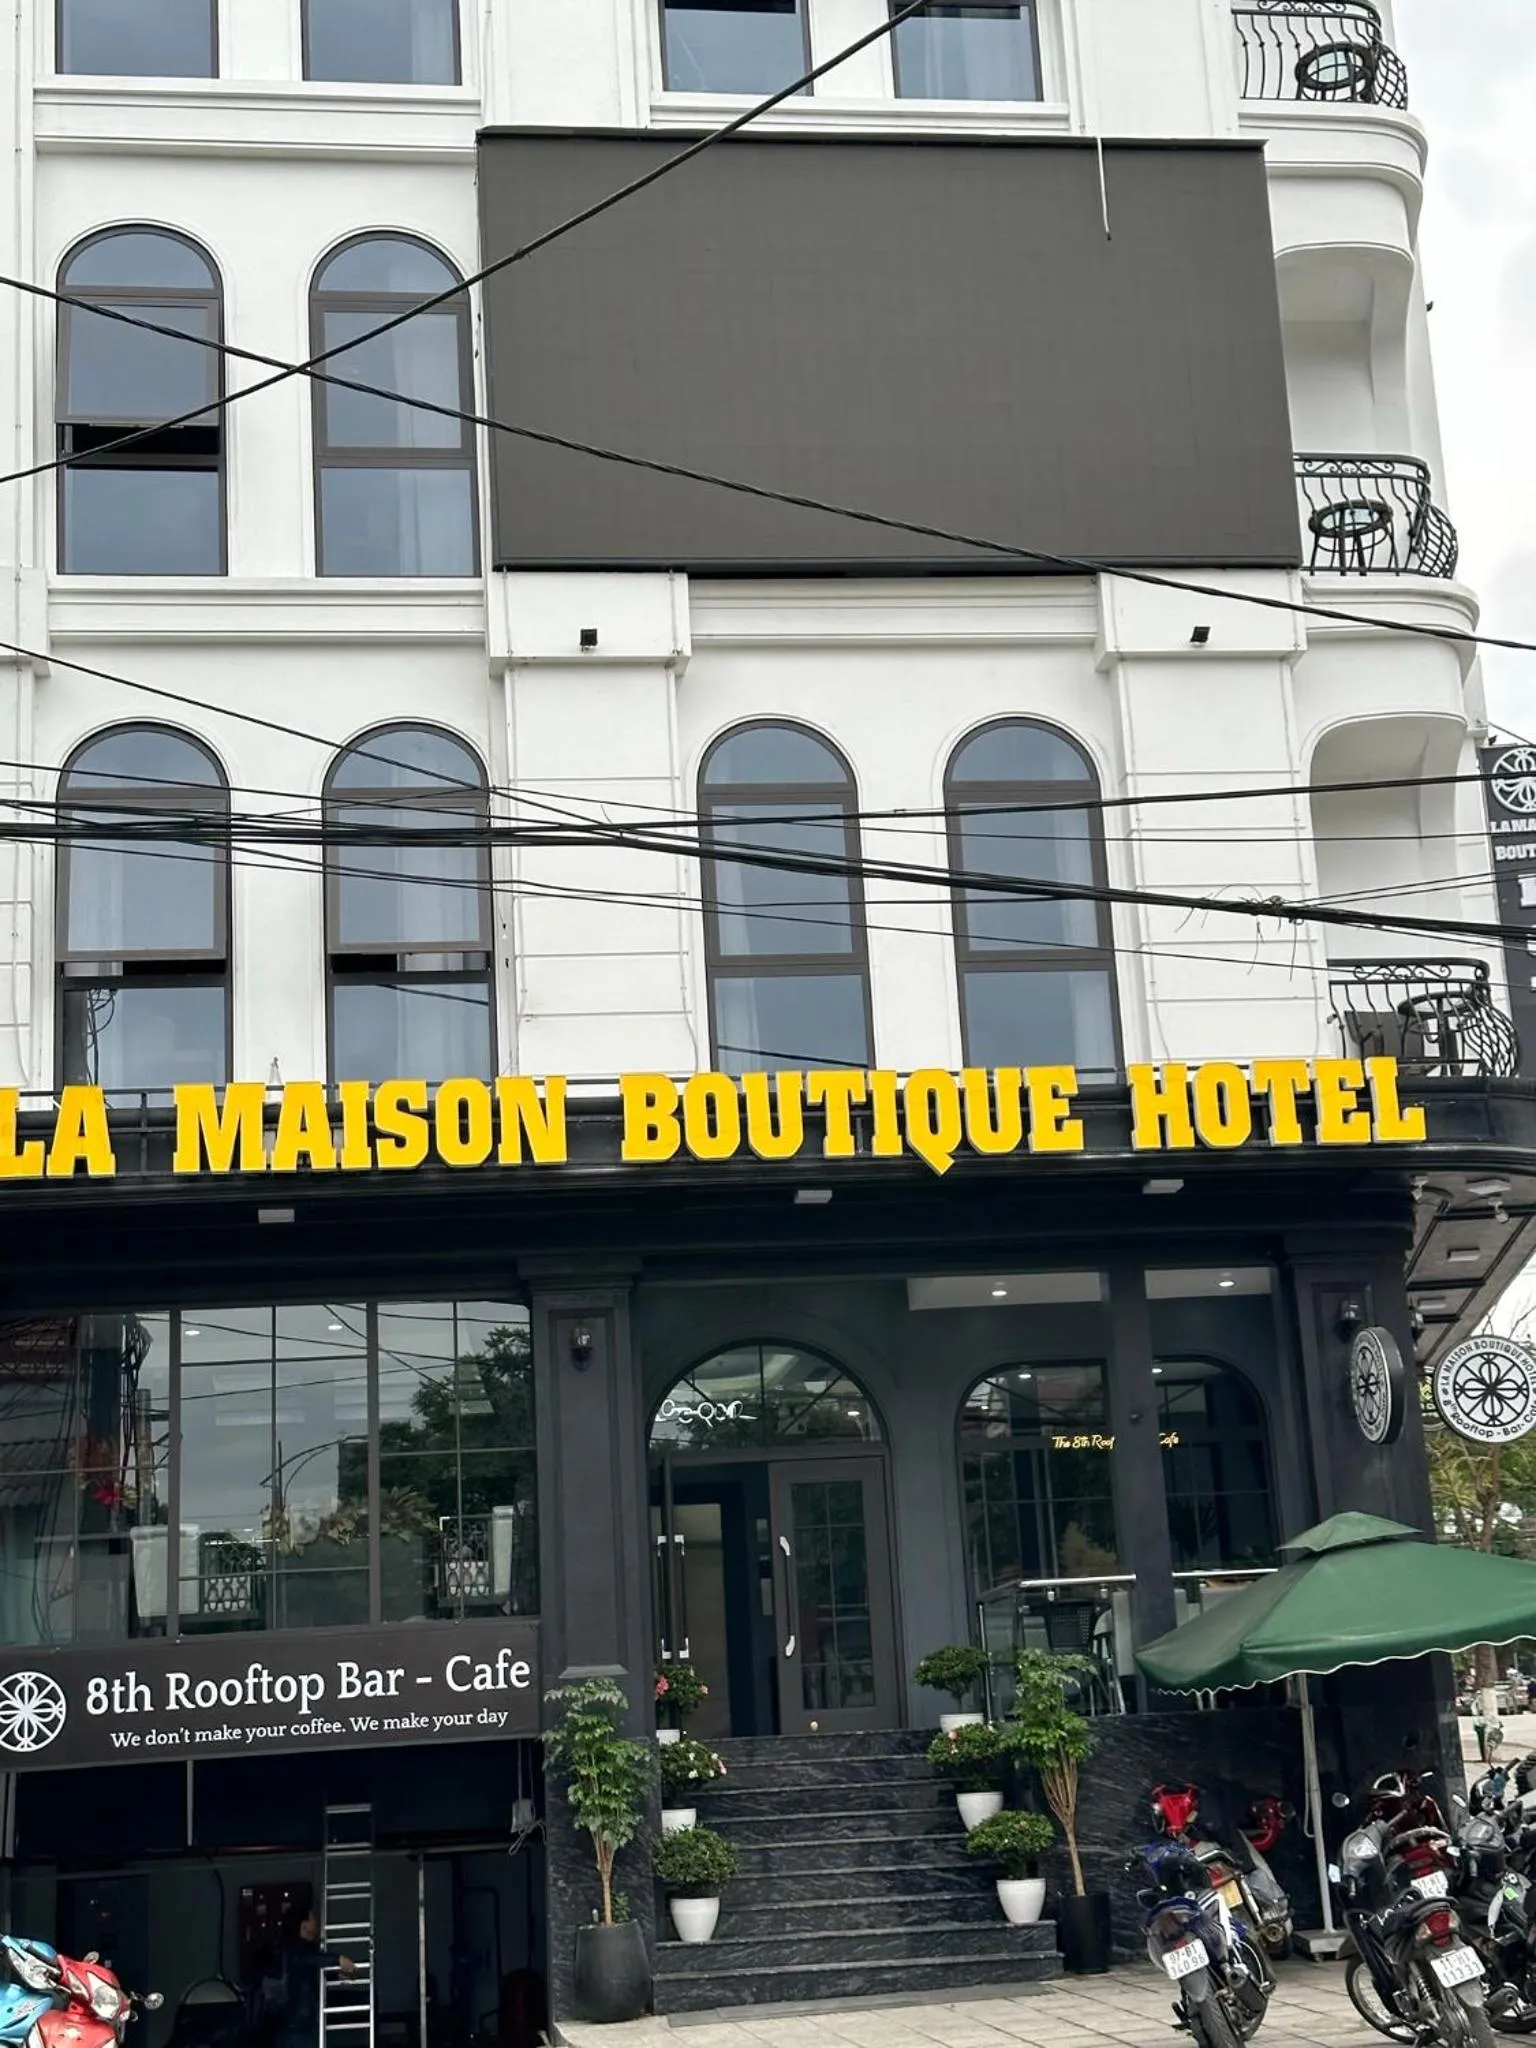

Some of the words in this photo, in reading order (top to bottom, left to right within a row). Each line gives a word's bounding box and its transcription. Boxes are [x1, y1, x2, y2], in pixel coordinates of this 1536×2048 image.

[0, 1085, 116, 1178] LA
[173, 1075, 568, 1174] MAISON
[620, 1065, 1084, 1176] BOUTIQUE
[1128, 1056, 1427, 1150] HOTEL
[1443, 1343, 1473, 1372] MAISON
[1474, 1341, 1523, 1360] BOUTIQUE
[1051, 1436, 1071, 1449] The
[86, 1671, 154, 1715] 8th
[165, 1662, 325, 1715] Rooftop
[336, 1661, 405, 1699] Bar
[445, 1648, 531, 1692] Cafe
[110, 1732, 141, 1748] We
[145, 1727, 191, 1746] don't
[194, 1724, 242, 1743] make
[245, 1724, 287, 1744] your
[290, 1718, 346, 1736] coffee.
[349, 1716, 379, 1732] We
[382, 1712, 430, 1730] make
[432, 1713, 474, 1732] your
[476, 1707, 509, 1728] day
